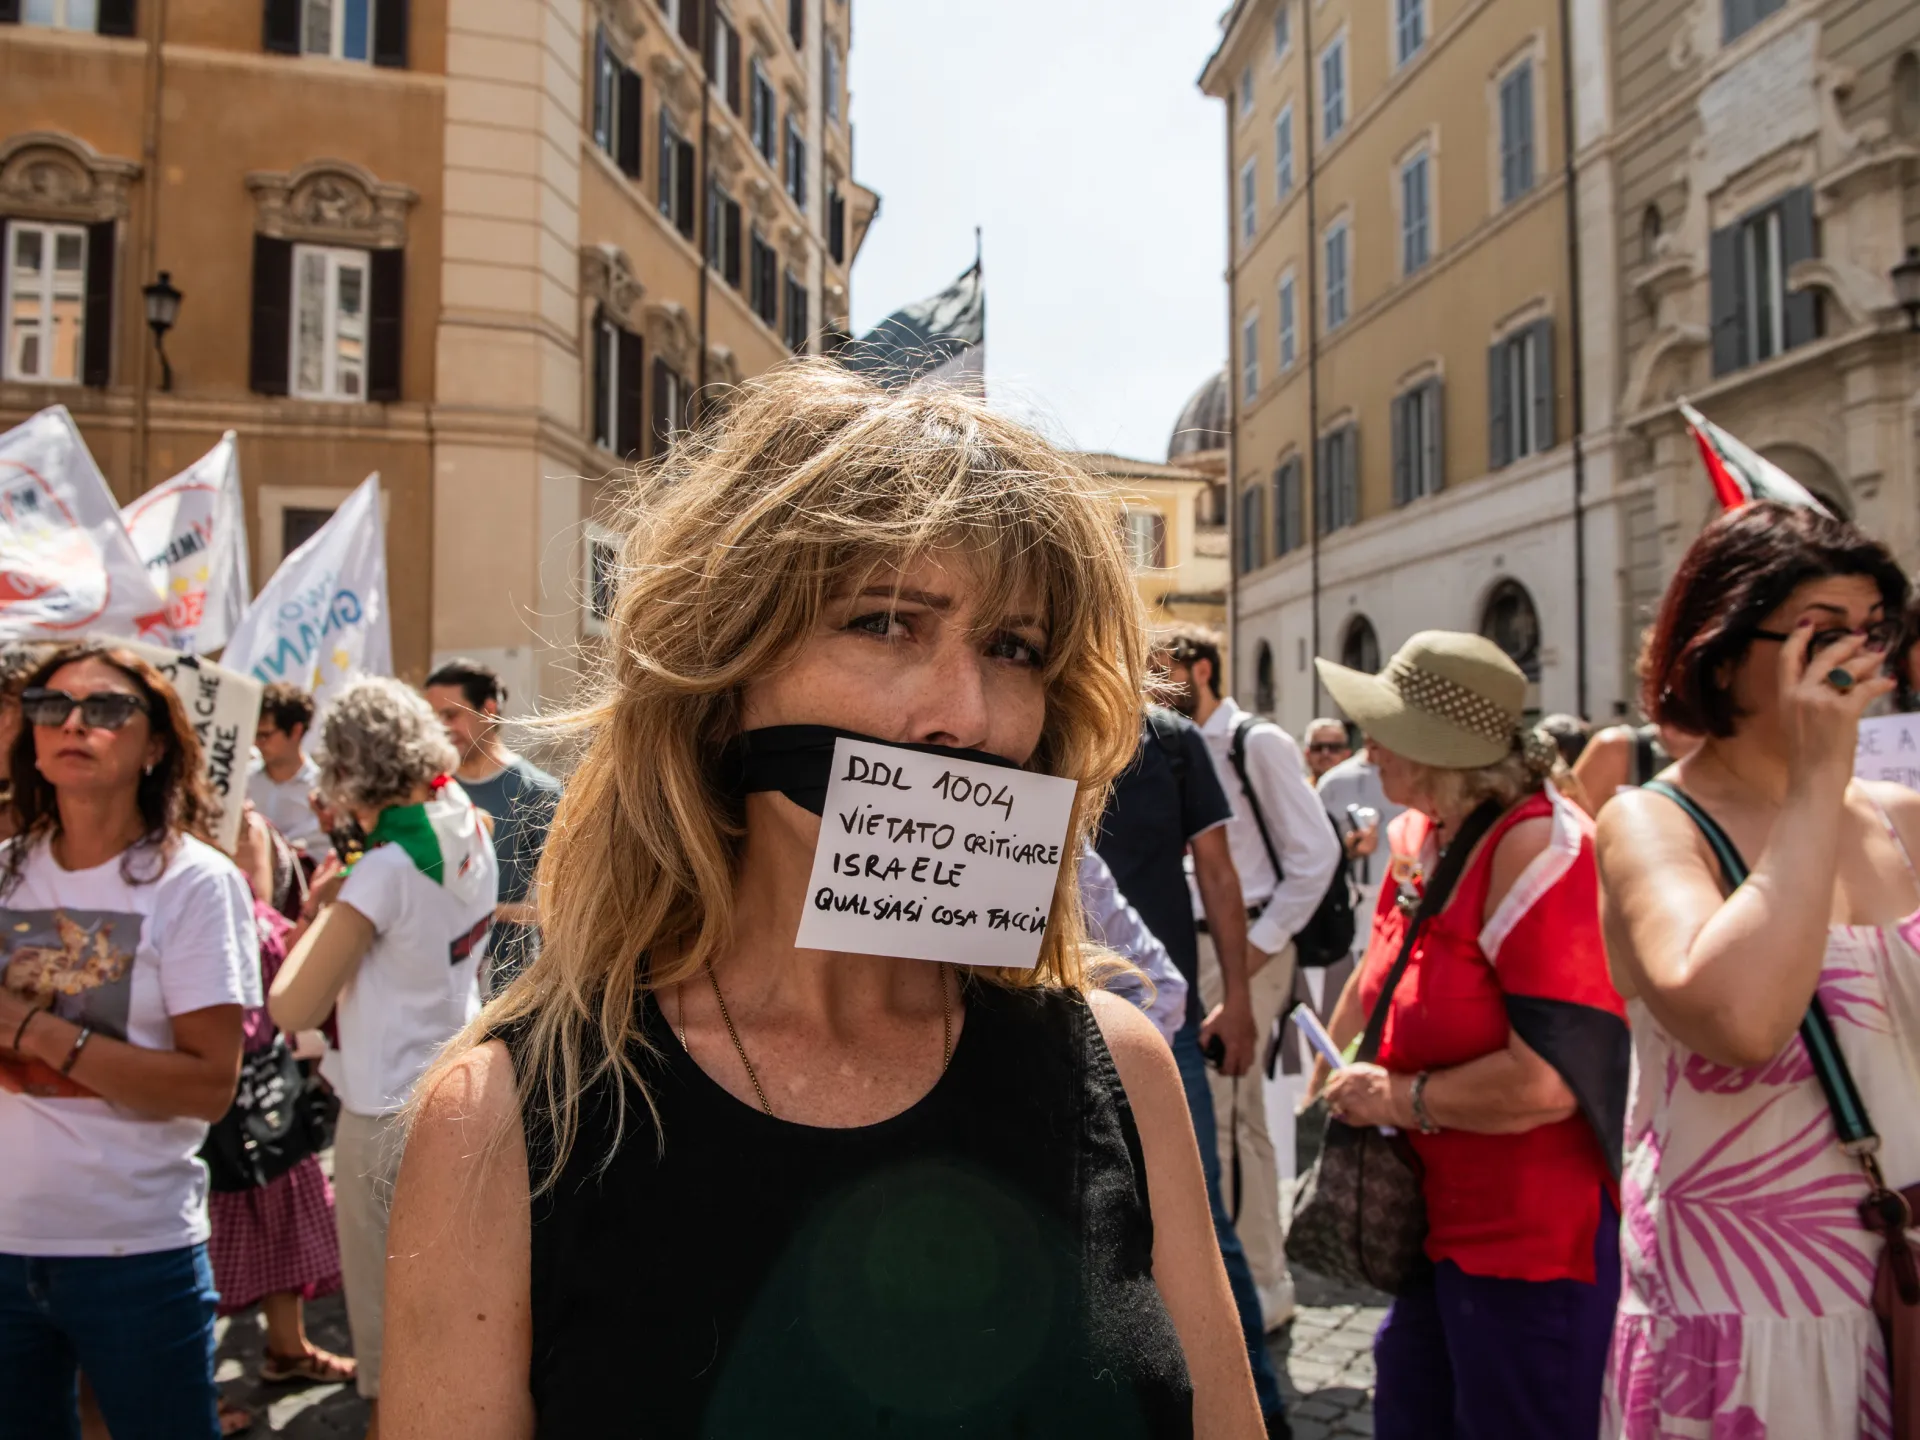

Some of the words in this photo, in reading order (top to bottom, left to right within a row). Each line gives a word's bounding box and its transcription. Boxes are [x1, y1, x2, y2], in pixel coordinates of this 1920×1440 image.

[841, 755, 912, 790] DDL
[932, 770, 1014, 822] 1004
[833, 853, 967, 888] ISRAELE
[931, 905, 978, 927] COSA
